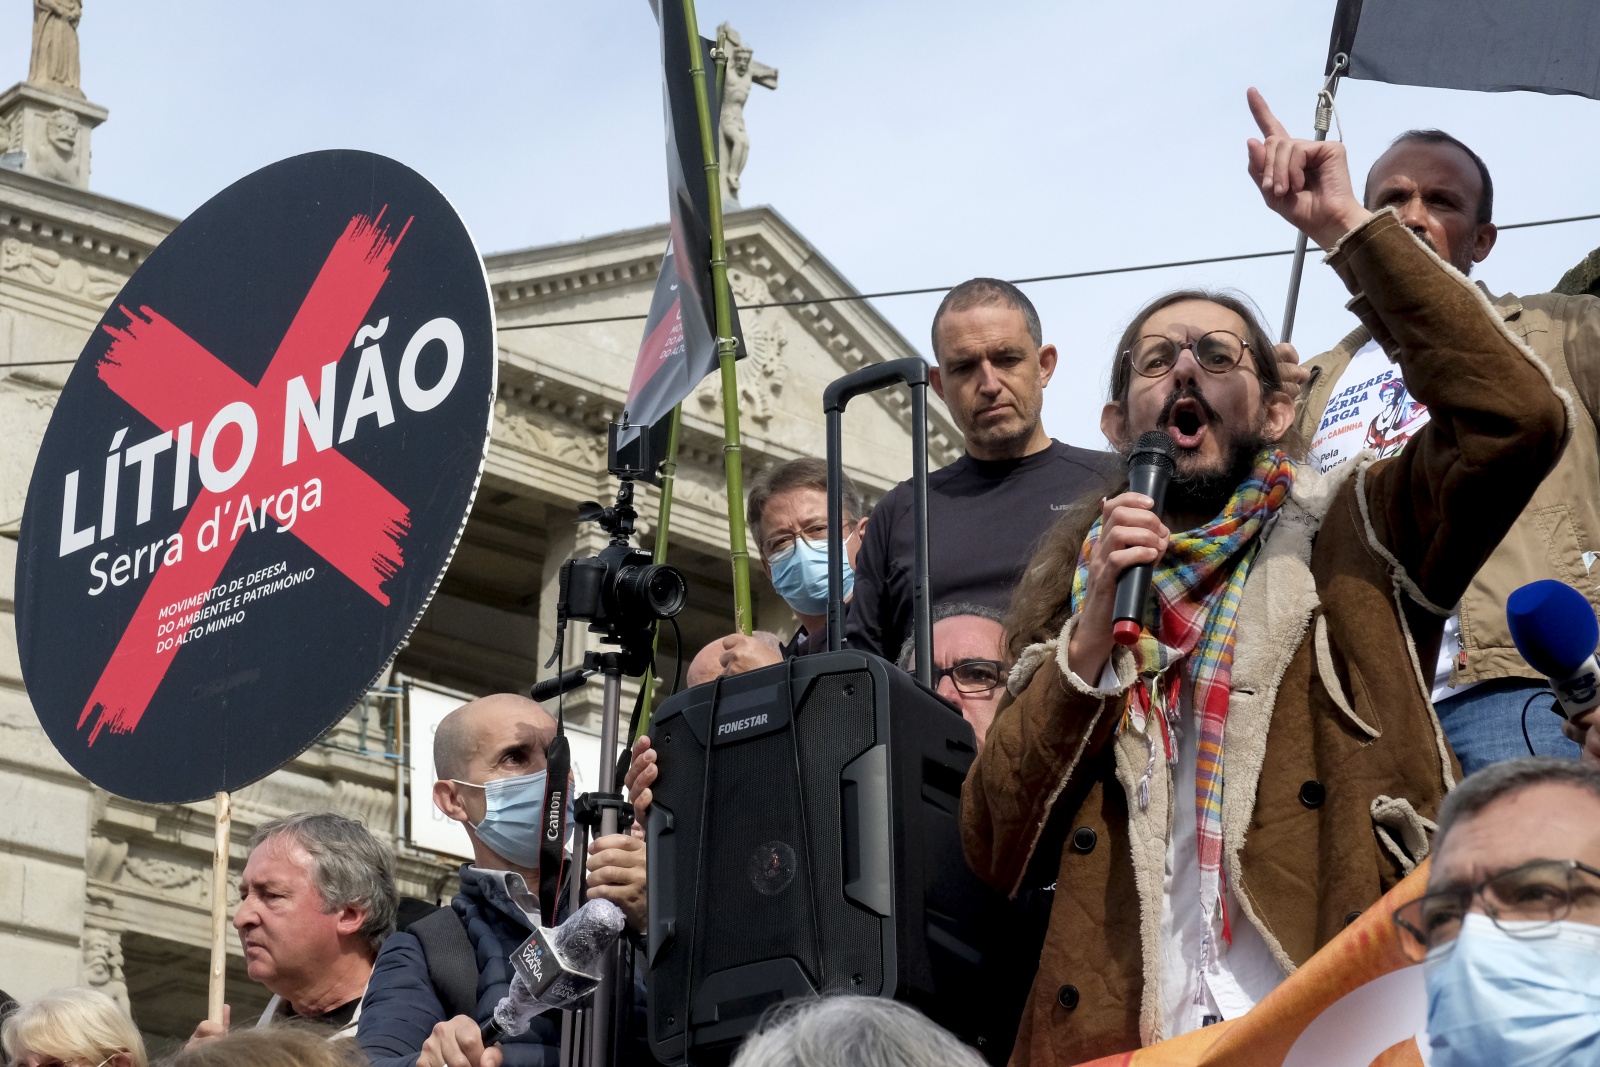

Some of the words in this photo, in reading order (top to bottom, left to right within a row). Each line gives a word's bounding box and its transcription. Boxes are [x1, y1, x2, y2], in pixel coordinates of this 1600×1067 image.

[59, 401, 258, 558] LÍTIO
[282, 316, 465, 465] NÃO
[1327, 421, 1363, 440] CAMINHA
[1320, 449, 1339, 464] Pela
[88, 533, 182, 596] Serra
[197, 477, 323, 552] d'Arga
[157, 621, 175, 637] DO
[176, 598, 232, 630] AMBIENTE
[233, 595, 241, 607] E
[242, 567, 315, 605] PATRIMÓNIO
[158, 584, 227, 620] MOVIMENTO
[229, 577, 245, 593] DE
[246, 560, 287, 586] DEFESA
[156, 638, 174, 654] DO
[175, 626, 204, 647] ALTO
[205, 610, 246, 636] MINHO
[717, 713, 768, 736] FONESTAR
[546, 791, 562, 842] Canon
[522, 948, 543, 983] VIANA
[527, 944, 542, 970] CANAL
